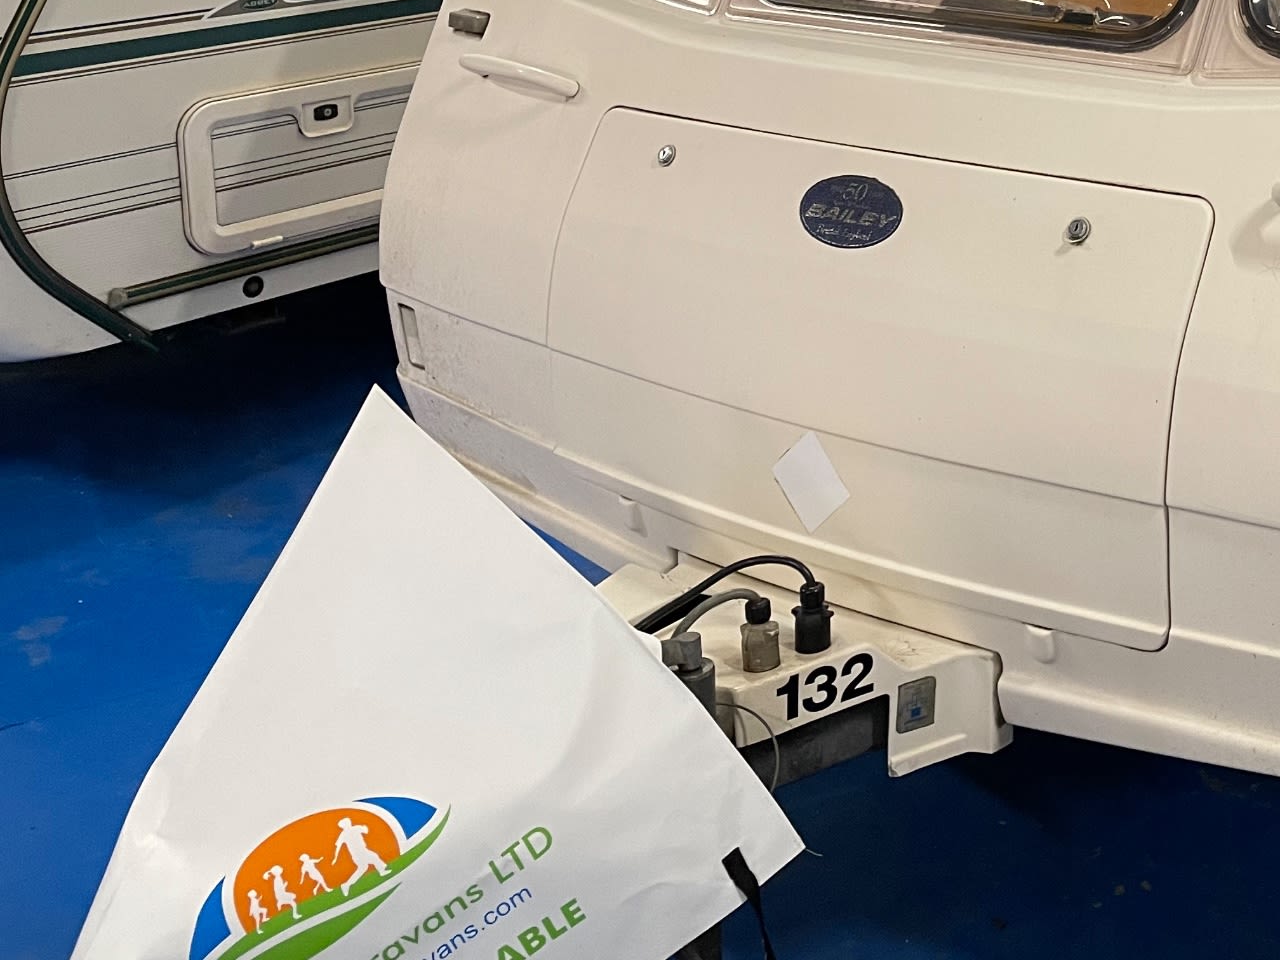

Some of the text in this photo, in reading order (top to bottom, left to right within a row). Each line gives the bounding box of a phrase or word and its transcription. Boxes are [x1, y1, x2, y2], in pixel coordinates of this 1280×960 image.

[804, 202, 897, 228] BAILEY
[776, 652, 874, 721] 132
[489, 826, 553, 884] LTD
